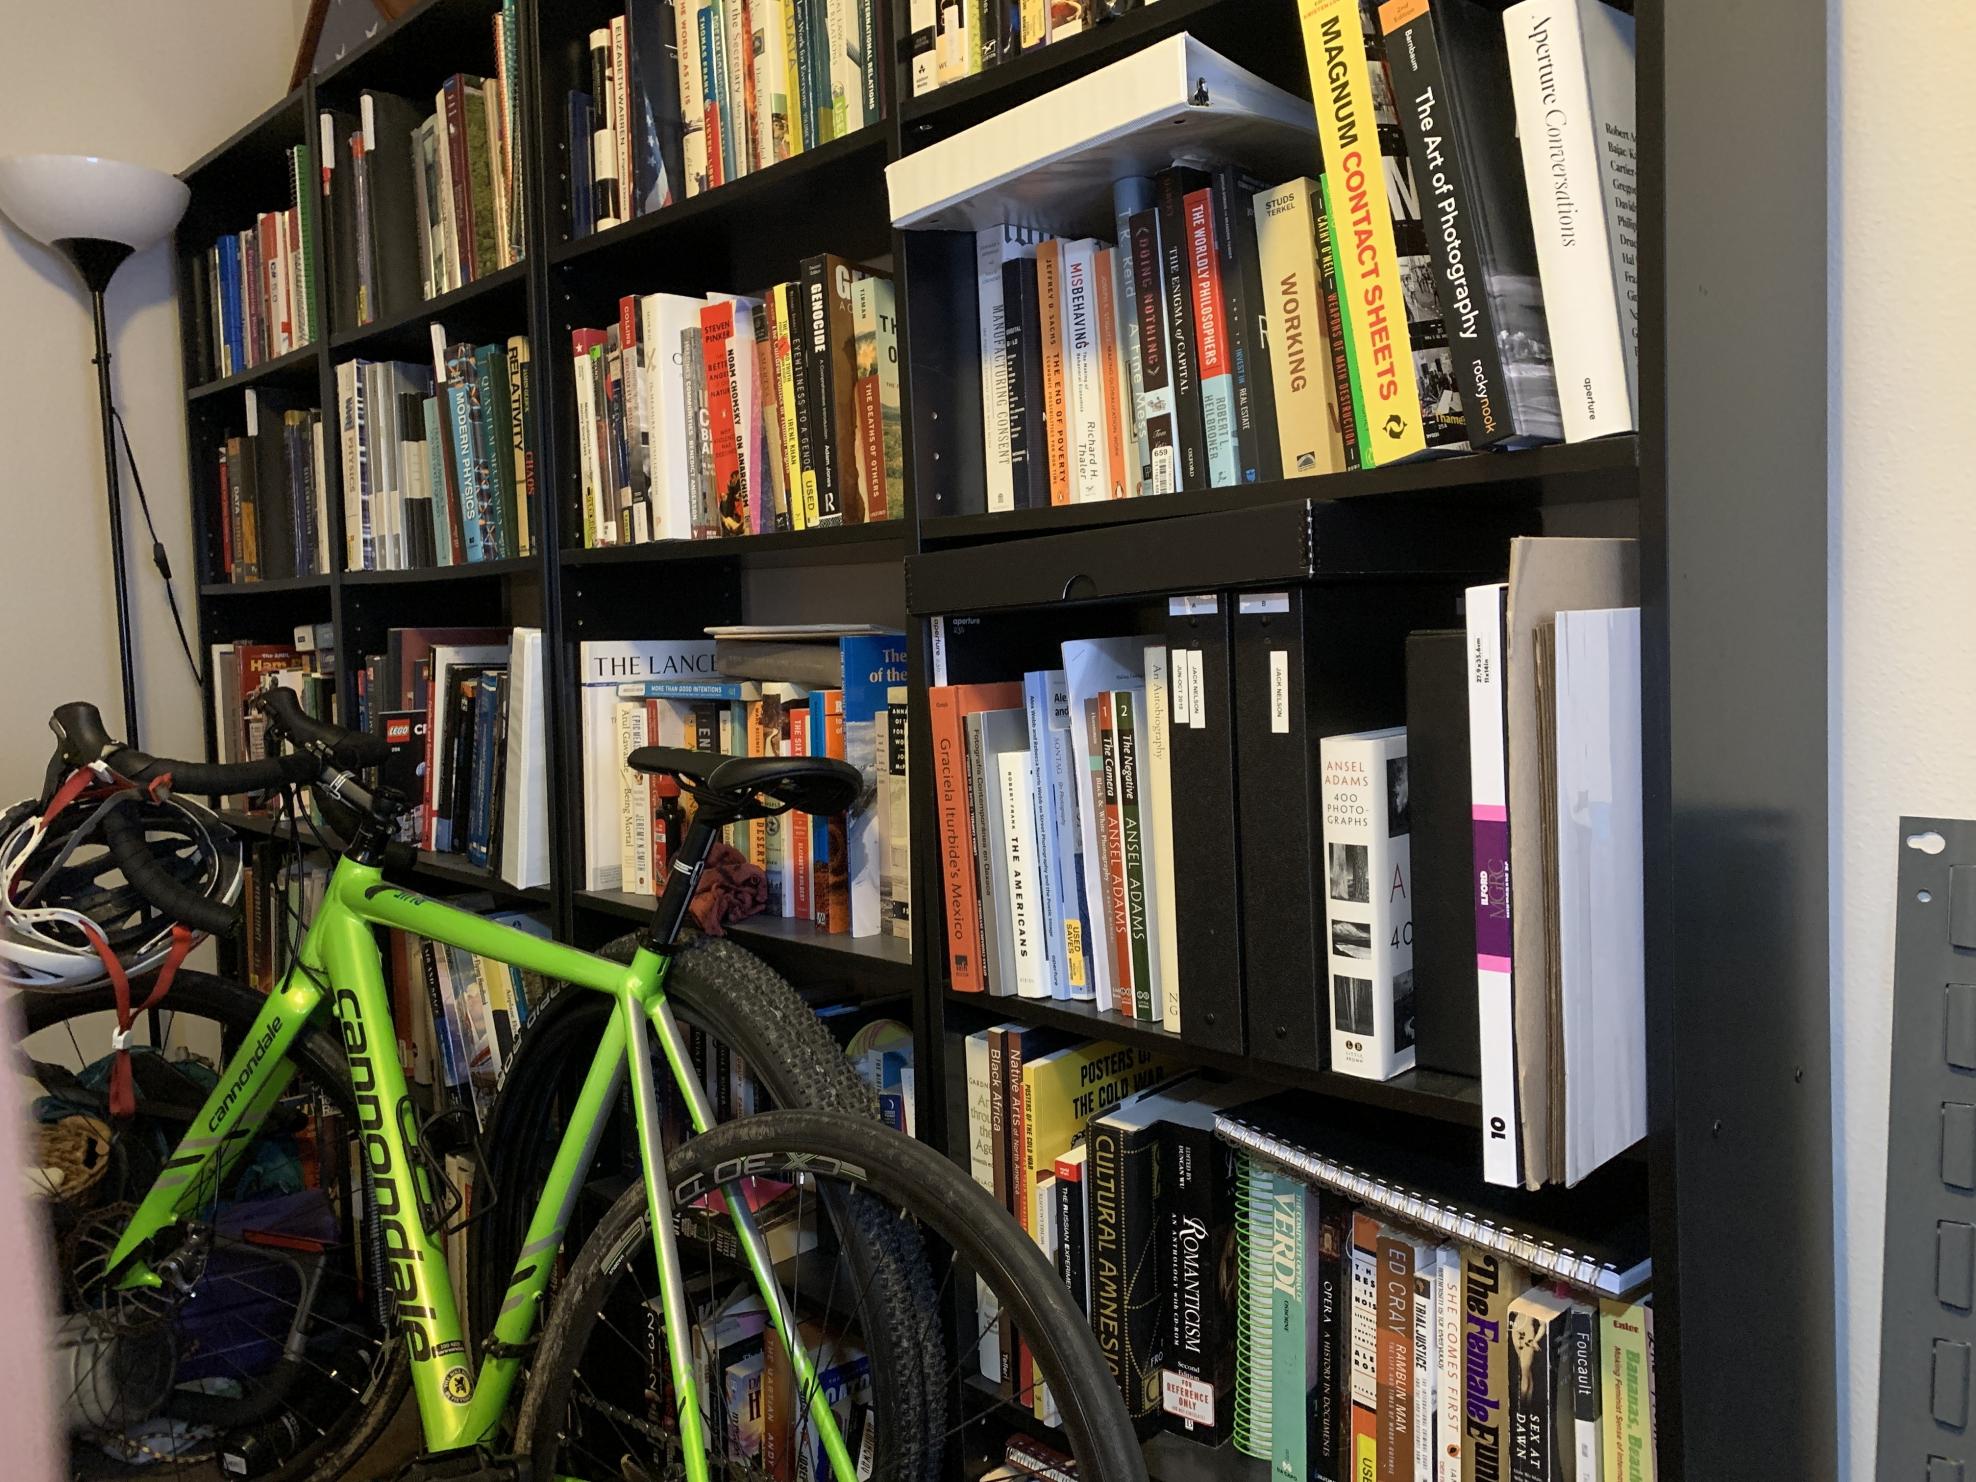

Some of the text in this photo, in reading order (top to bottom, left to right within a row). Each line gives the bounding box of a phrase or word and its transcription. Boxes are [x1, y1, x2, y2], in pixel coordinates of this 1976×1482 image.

[616, 26, 624, 88] ELIZABETH
[1404, 28, 1418, 72] Barnbaum
[1528, 16, 1575, 247] Aperture Conversations
[1605, 122, 1628, 141] Robert
[1266, 193, 1294, 210] STUDS
[1266, 202, 1296, 216] TERKEL
[1320, 16, 1398, 400] MAGNUM CONTACT SHEETS
[1416, 86, 1480, 340] The Art of Photography
[1046, 260, 1054, 299] JEFFREY
[1192, 204, 1216, 366] THE WORLDLY PHILOSOPHERS
[811, 284, 825, 354] GENOCIDE
[1070, 262, 1090, 350] MISBEHAVING
[1168, 245, 1190, 396] THE ENIGMA of CAPITAL
[704, 322, 730, 335] STEVEN
[706, 331, 731, 344] PINKER
[1281, 273, 1307, 393] WORKING
[1318, 214, 1356, 446] CATHY O'NEIL WEAPONS OF MATH DESTRUCTION
[728, 349, 736, 374] NOAM
[1052, 352, 1060, 376] THE
[508, 346, 523, 450] RELATIVITY
[730, 378, 741, 425] CHOMSKY
[992, 304, 1010, 464] MANUFACTURING CONSENT
[1054, 382, 1062, 405] END
[1472, 359, 1496, 434] rockynook
[1584, 378, 1597, 421] aperture
[686, 380, 694, 436] COMMUNITIES
[867, 404, 875, 444] DEATHS
[1056, 410, 1062, 424] OF
[1205, 394, 1218, 460] HEILBRONER
[456, 392, 476, 520] MODERN PHYSICS
[482, 376, 502, 525] QUANTUM MECHANICS
[688, 440, 696, 476] BENEDICT
[736, 436, 742, 448] ON
[870, 446, 876, 457] OF
[1056, 430, 1066, 482] POVERTY
[1078, 444, 1087, 480] Thaler
[526, 452, 535, 496] CHAOS
[738, 451, 749, 508] ANARCHISM
[805, 481, 814, 510] USED
[871, 460, 879, 497] OTHERS
[690, 480, 698, 520] ANDERSON
[250, 660, 286, 672] Ham
[594, 656, 641, 677] THE
[882, 648, 907, 663] The
[389, 726, 408, 736] LEGO
[1153, 664, 1166, 760] An Autobiography
[1104, 738, 1114, 797] The Camera
[1122, 735, 1134, 799] The Negative
[1325, 774, 1369, 786] ADAMS
[1326, 761, 1364, 774] ANSEL
[624, 788, 634, 846] Being Mortal
[1328, 804, 1369, 814] PHOTO-
[1334, 793, 1358, 802] 400
[636, 814, 646, 872] JEREMY SMITH
[757, 822, 765, 864] DESERT
[940, 738, 963, 940] Graciela Iturbide's Mexico
[1327, 816, 1368, 826] GRAPHS
[1108, 816, 1126, 933] ANSEL ADAMS
[1126, 818, 1144, 940] ANSEL ADAMS
[1480, 870, 1488, 906] ILFORD
[207, 1016, 282, 1132] cannondale
[991, 1049, 1002, 1132] Black Africa
[1010, 1050, 1021, 1092] Native
[1080, 1050, 1134, 1087] POSTERS
[1013, 1096, 1021, 1126] Arts
[1072, 1093, 1094, 1119] THE
[1098, 1080, 1128, 1108] COLD
[1013, 1129, 1018, 1137] of
[1490, 1117, 1506, 1140] 10
[336, 988, 436, 1362] cannondale
[1096, 1136, 1116, 1256] CULTURAL
[1274, 1194, 1296, 1300] VERDI
[1178, 1216, 1208, 1354] ROMANTICISM
[1324, 1280, 1332, 1323] OPERA
[1388, 1248, 1407, 1434] ED CRAY RAMBLIN' MAN
[1416, 1302, 1426, 1372] TRIAL JUSTICE
[1447, 1284, 1459, 1434] SHE COMES FIRST
[1466, 1254, 1500, 1423] The Female
[1178, 1361, 1200, 1374] Second
[1182, 1380, 1192, 1388] FOR
[1576, 1332, 1592, 1396] Foucault
[1167, 1382, 1208, 1404] REFERENCE
[1178, 1397, 1196, 1410] ONLY
[1324, 1383, 1330, 1393] IN
[1626, 1349, 1640, 1429] Bananas,
[1516, 1412, 1526, 1459] DAWN
[1530, 1414, 1541, 1468] SEX AT
